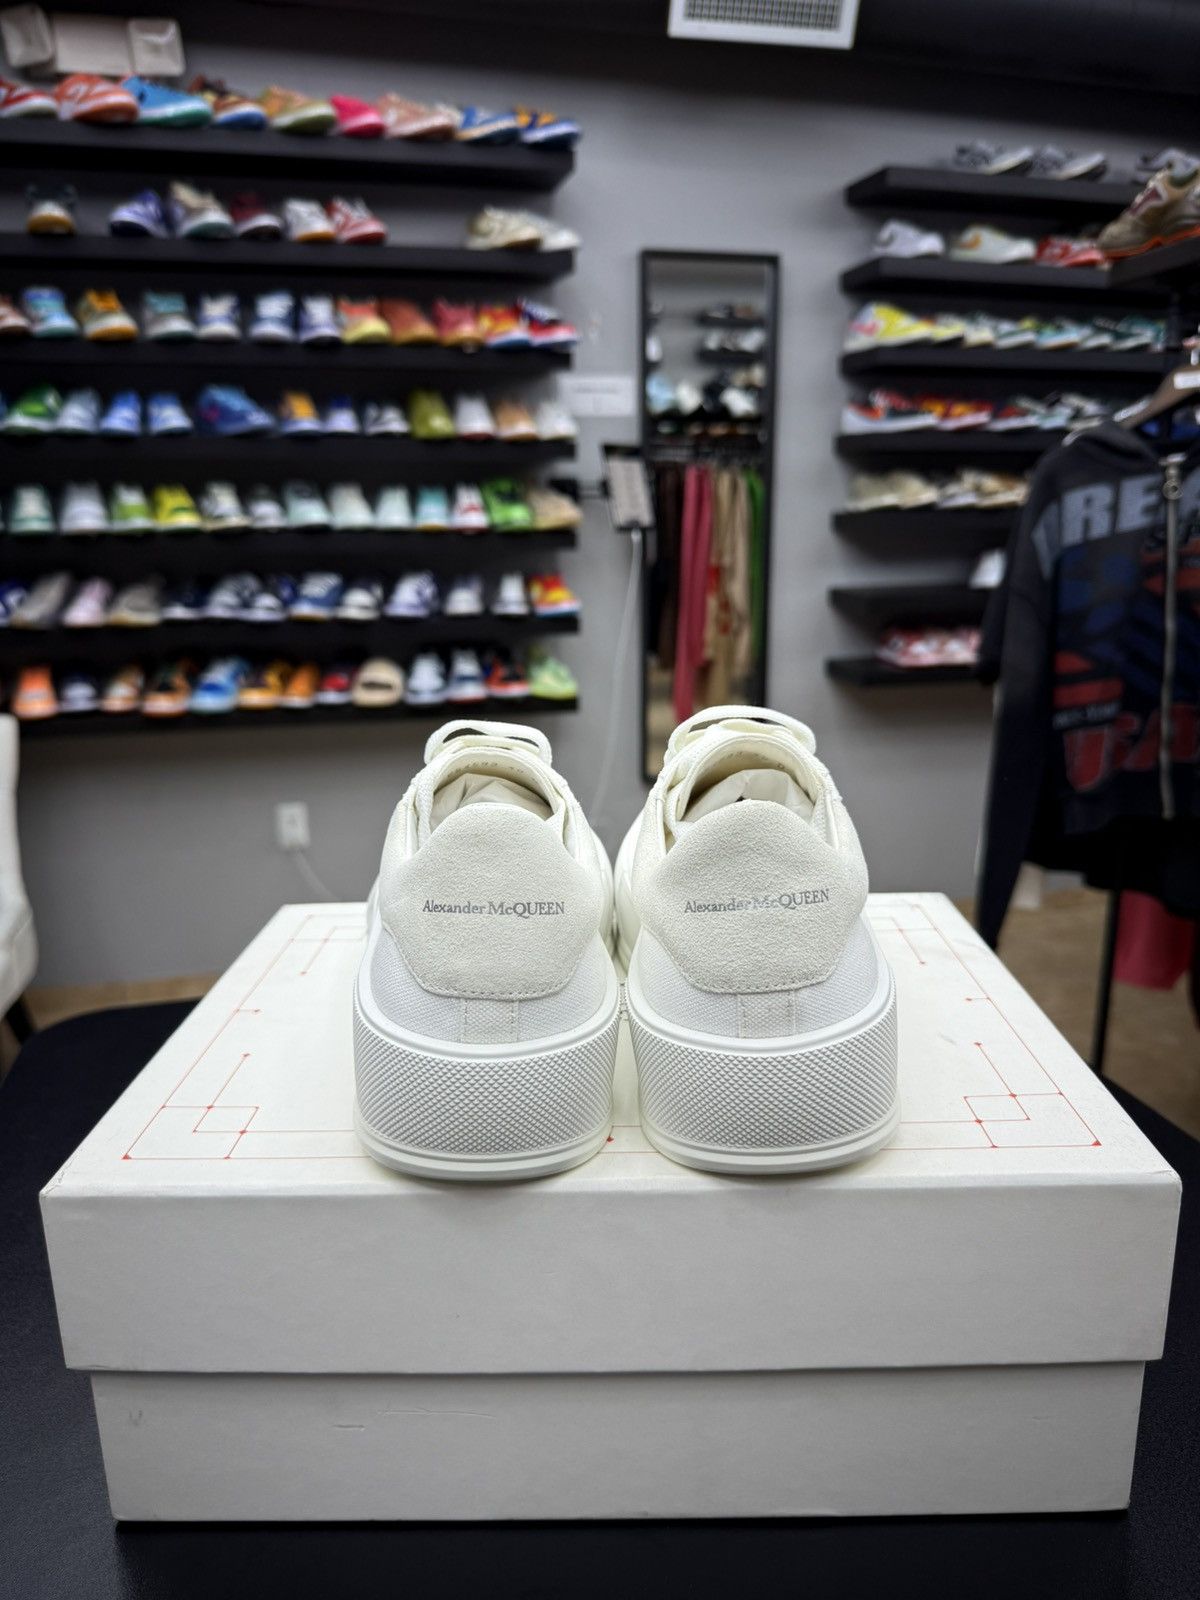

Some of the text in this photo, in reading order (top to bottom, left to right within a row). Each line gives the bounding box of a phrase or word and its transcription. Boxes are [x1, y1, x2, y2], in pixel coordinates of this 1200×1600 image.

[422, 900, 565, 919] Alexander McQUEEN
[684, 898, 752, 913] Alexander
